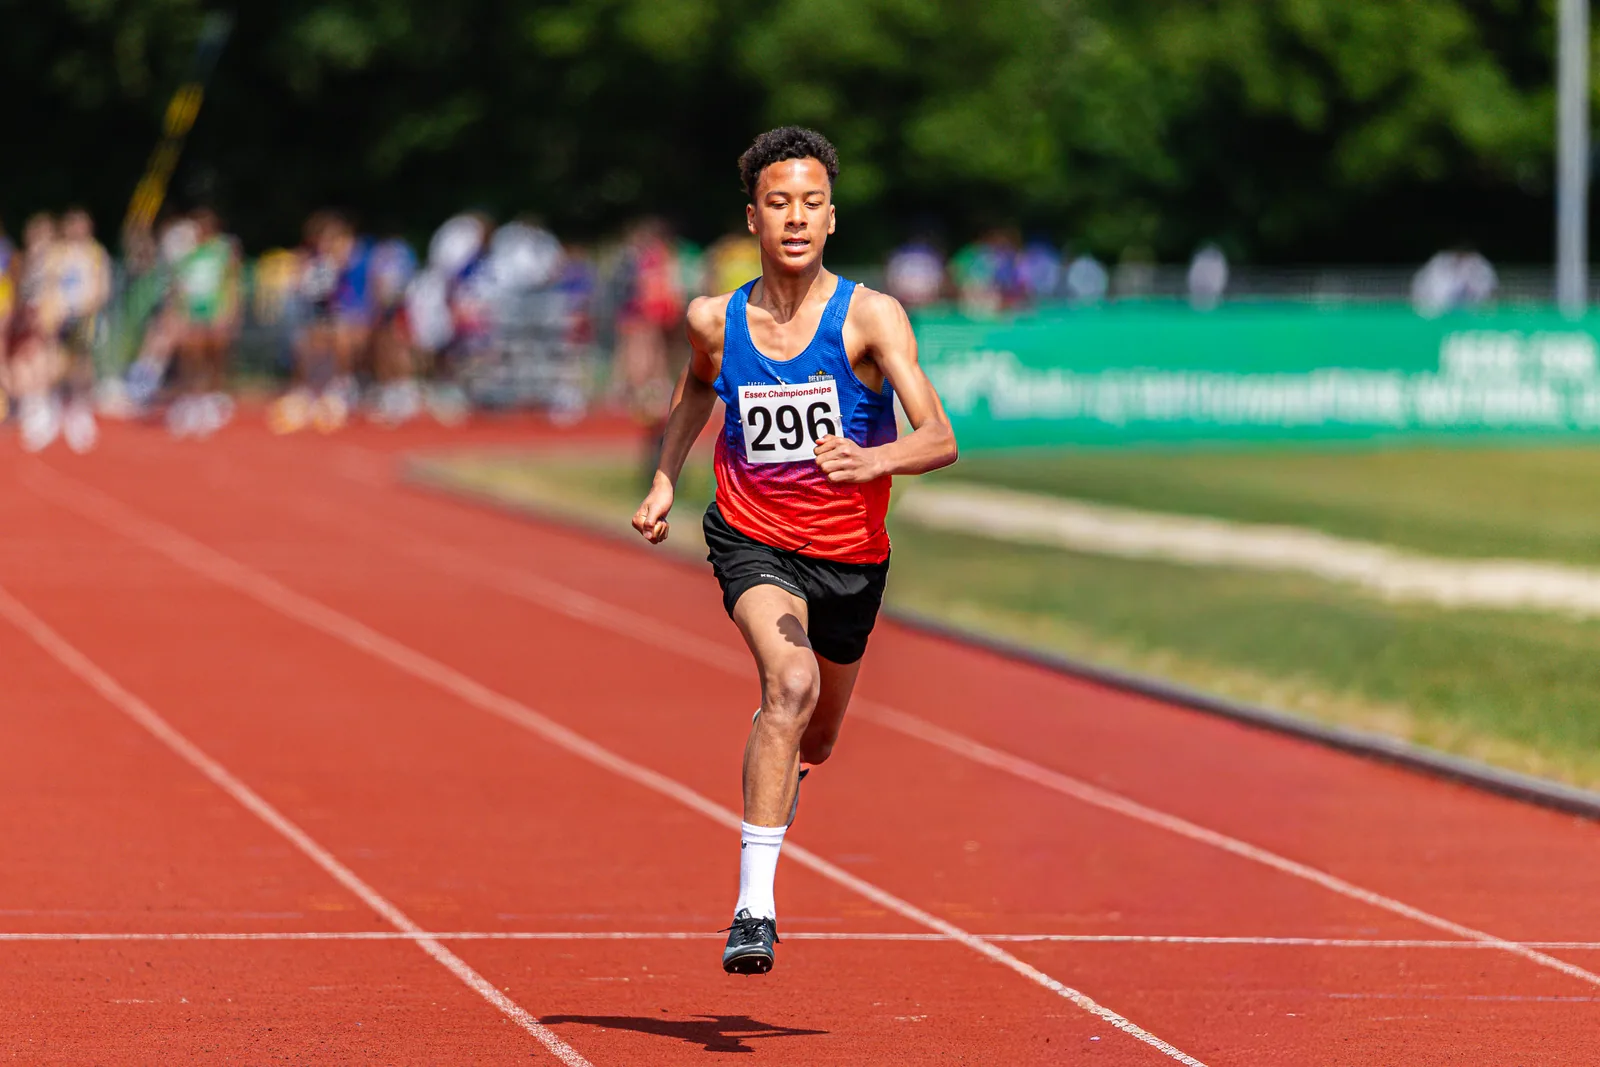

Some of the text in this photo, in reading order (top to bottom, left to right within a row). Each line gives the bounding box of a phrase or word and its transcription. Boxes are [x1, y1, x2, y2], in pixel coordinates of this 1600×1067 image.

[744, 386, 832, 399] Essex Championships
[747, 402, 836, 451] 296
